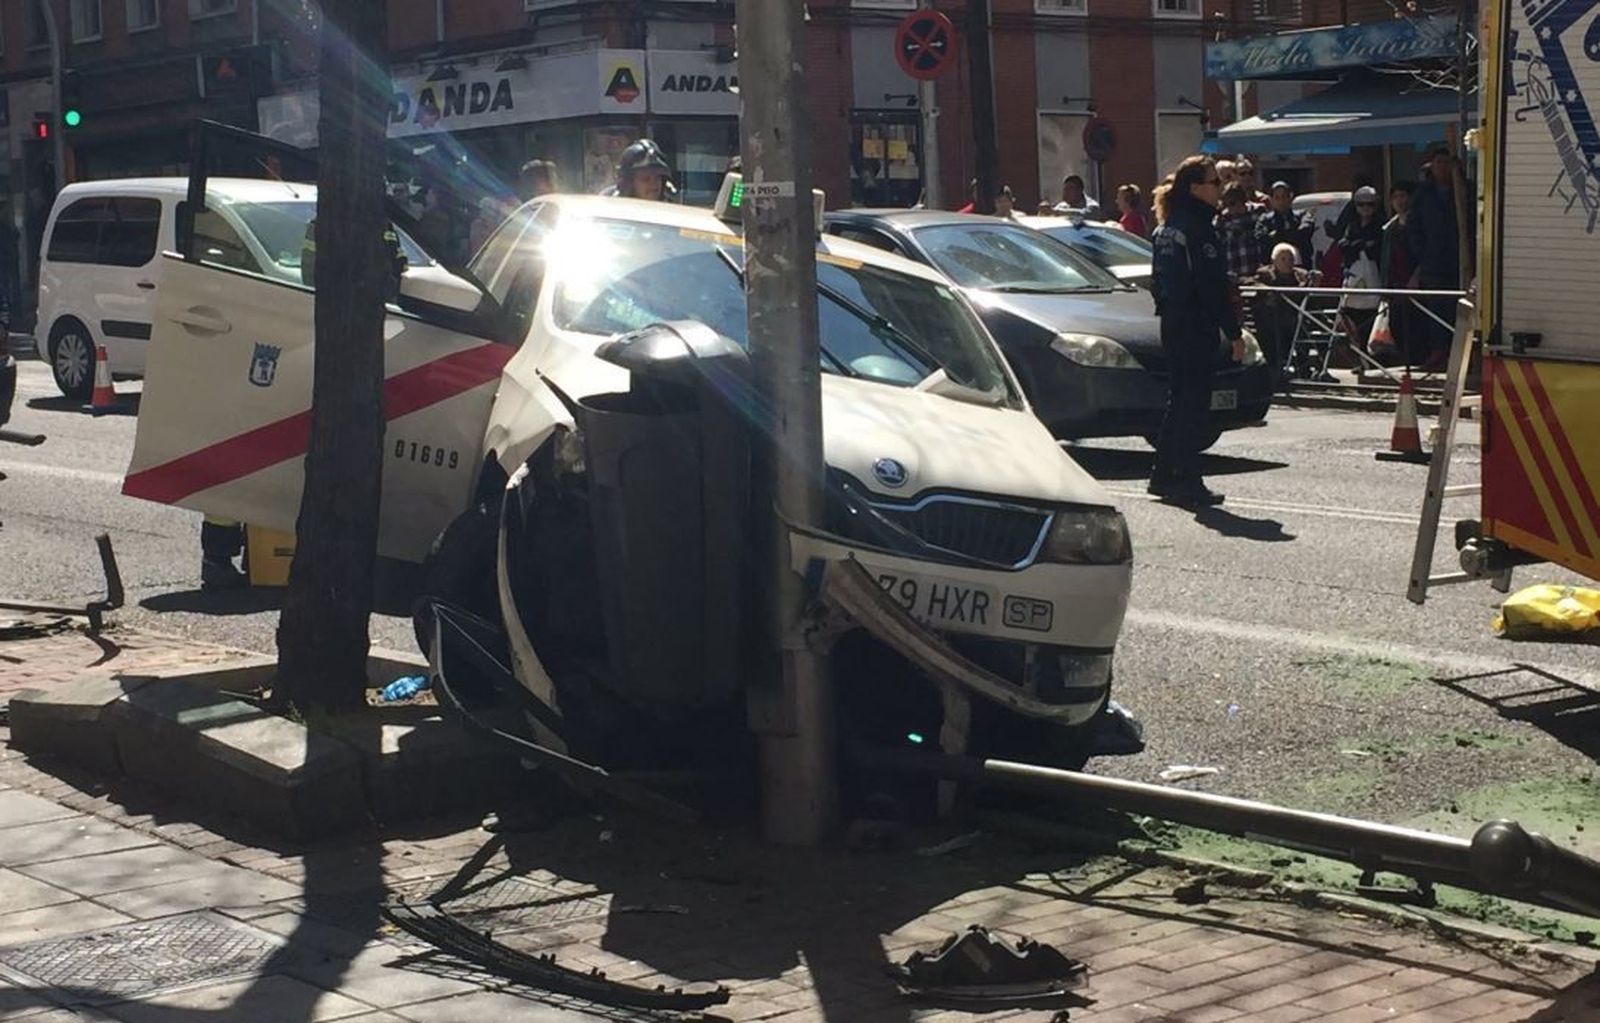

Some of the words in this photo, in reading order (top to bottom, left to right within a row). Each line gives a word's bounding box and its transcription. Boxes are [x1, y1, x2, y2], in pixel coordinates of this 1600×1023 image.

[394, 439, 459, 470] 01699
[927, 583, 989, 625] HXR
[1008, 601, 1050, 625] SP
